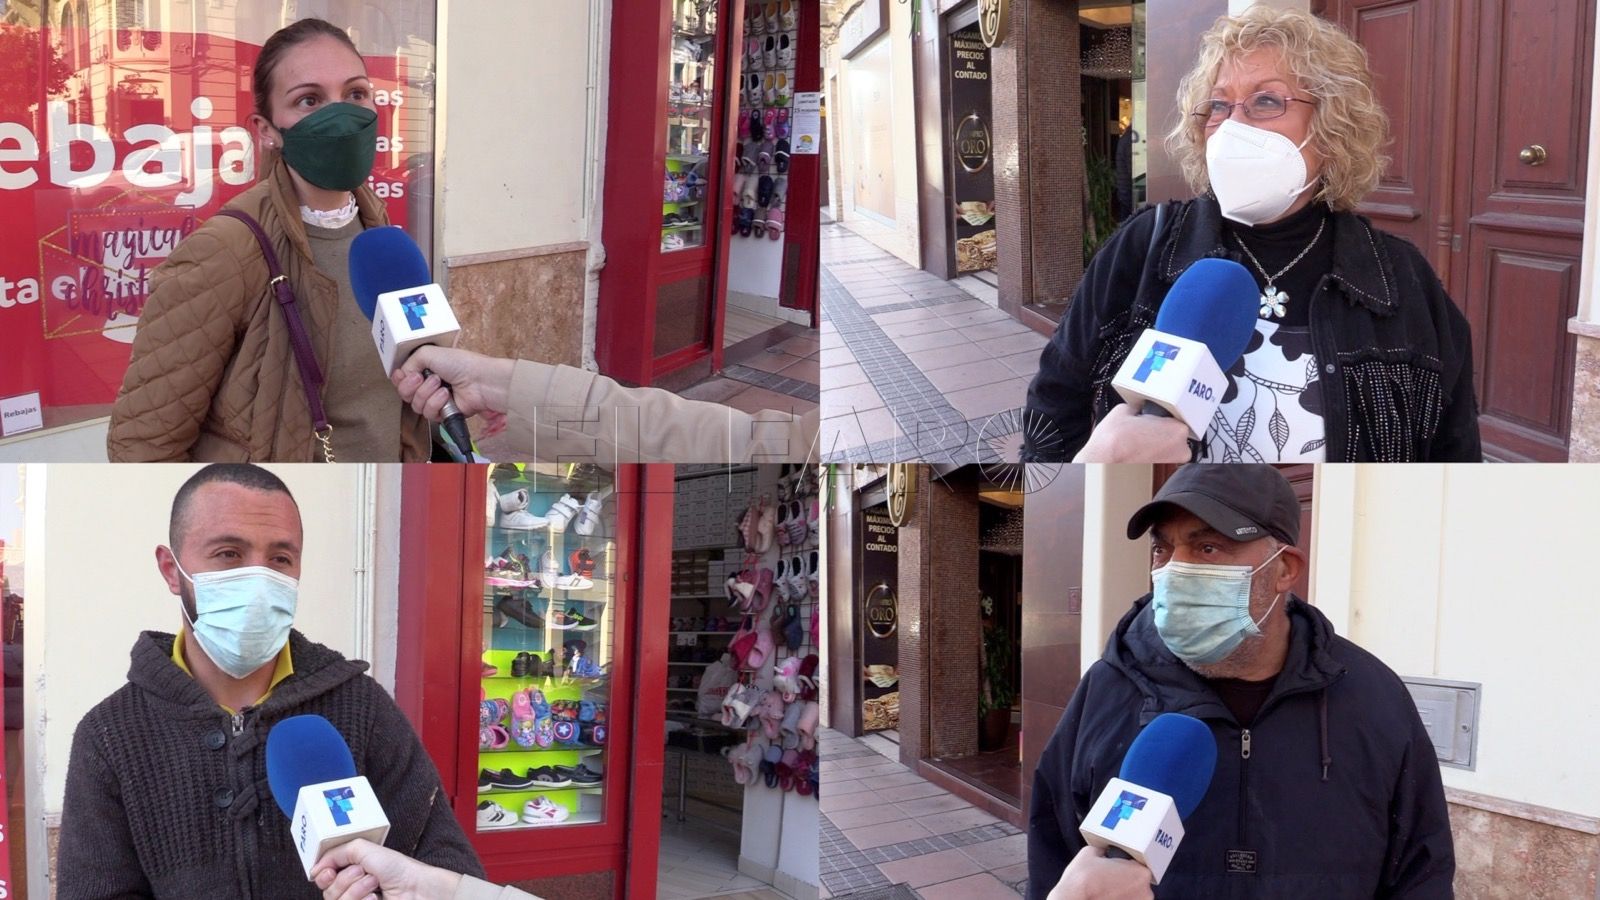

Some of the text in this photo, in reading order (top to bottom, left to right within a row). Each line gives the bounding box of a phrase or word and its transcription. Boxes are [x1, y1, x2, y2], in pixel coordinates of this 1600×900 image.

[957, 51, 984, 60] PRECIOS
[966, 61, 976, 70] AL
[955, 70, 988, 80] CONTADO
[961, 139, 985, 154] ORO
[4, 407, 37, 419] Rebajas
[868, 525, 895, 535] PRECIOS
[877, 535, 887, 543] AL
[866, 543, 898, 553] CONTADO
[870, 607, 894, 621] ORO
